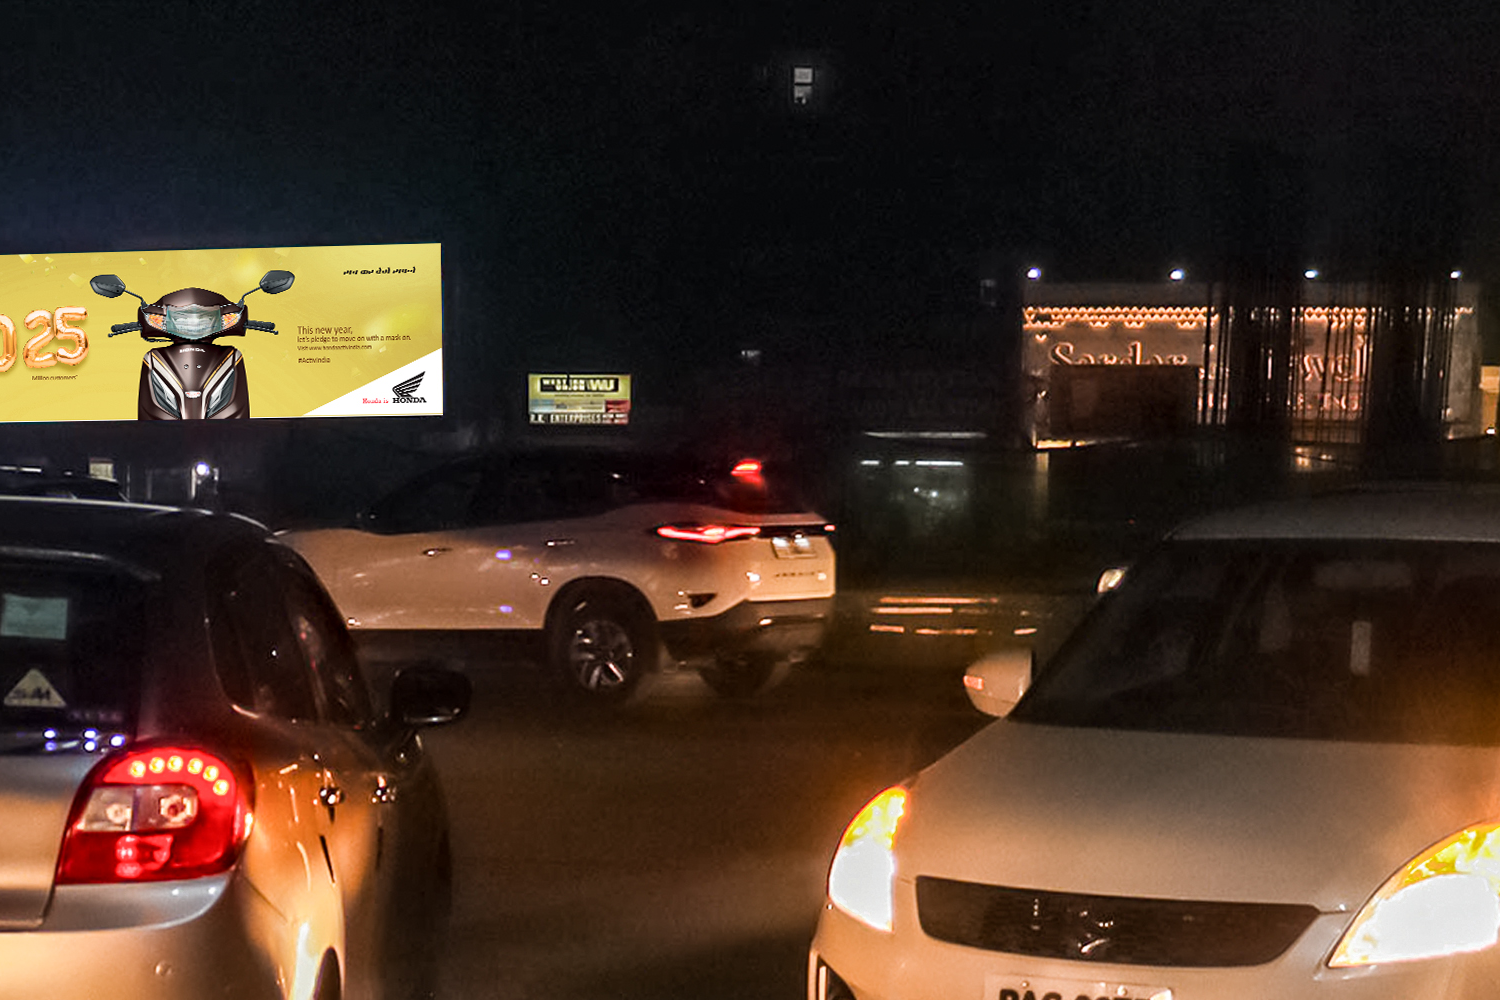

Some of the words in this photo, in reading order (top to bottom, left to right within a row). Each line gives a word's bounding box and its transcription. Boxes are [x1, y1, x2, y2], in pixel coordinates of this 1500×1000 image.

[297, 325, 314, 335] This
[315, 326, 332, 335] new
[333, 326, 353, 336] year,
[310, 335, 331, 344] pledge
[366, 334, 379, 342] with
